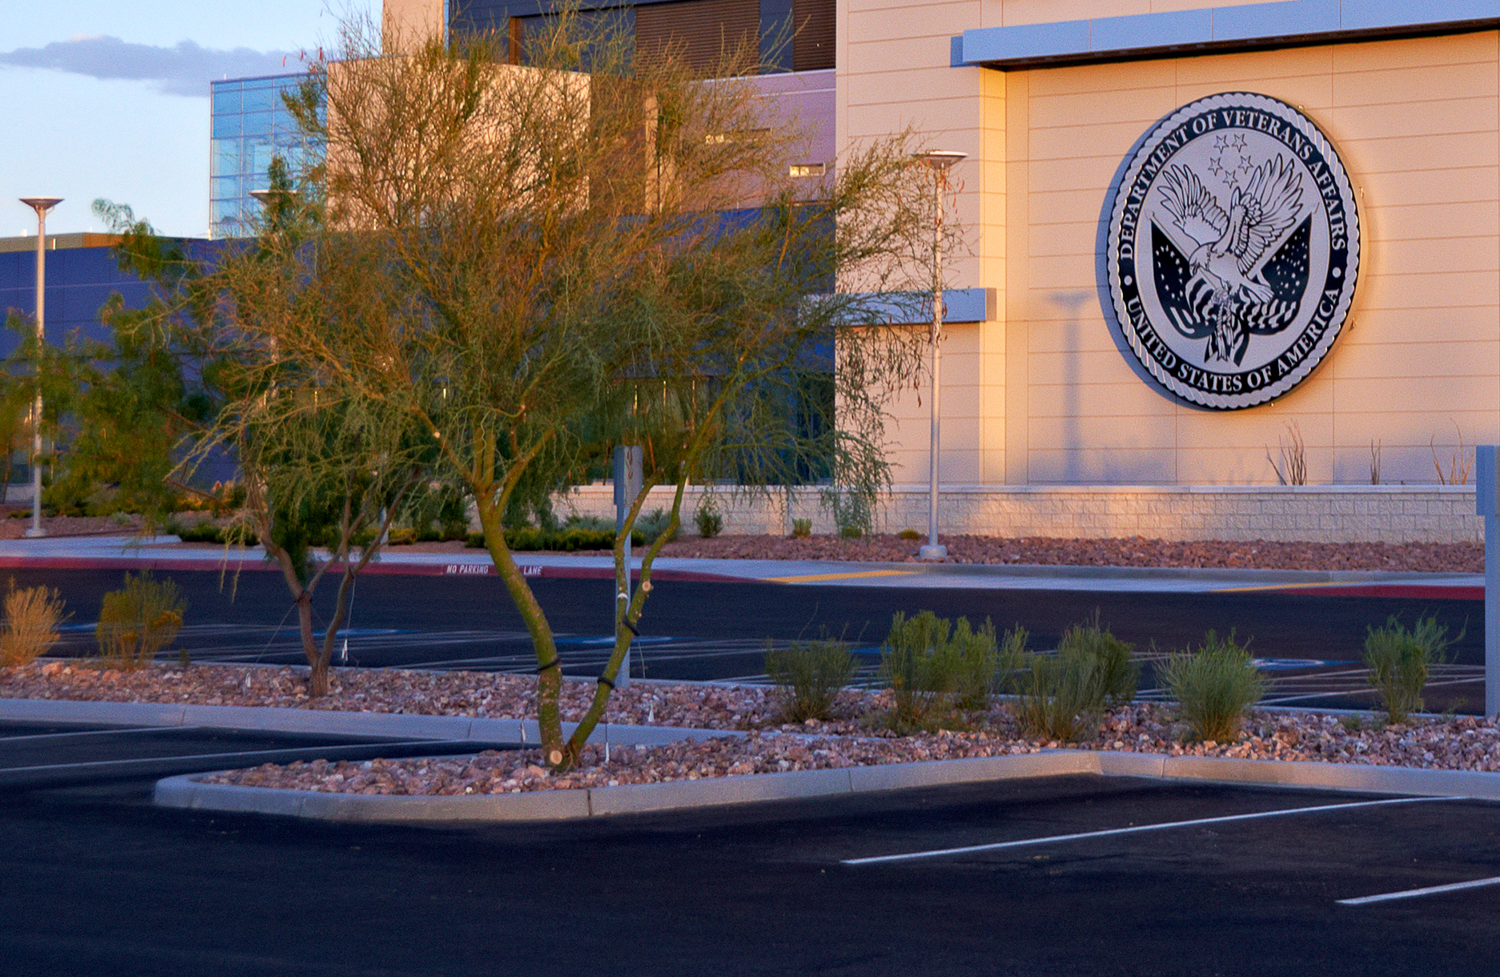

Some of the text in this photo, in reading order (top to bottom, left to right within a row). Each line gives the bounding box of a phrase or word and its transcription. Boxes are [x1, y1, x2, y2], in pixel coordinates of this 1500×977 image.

[1120, 110, 1346, 260] DEPARTMENT OF VETERANS AFFAIRS
[1127, 289, 1339, 392] UNITED STATES OF AMERICA
[446, 564, 543, 576] NO PARKING LANE
